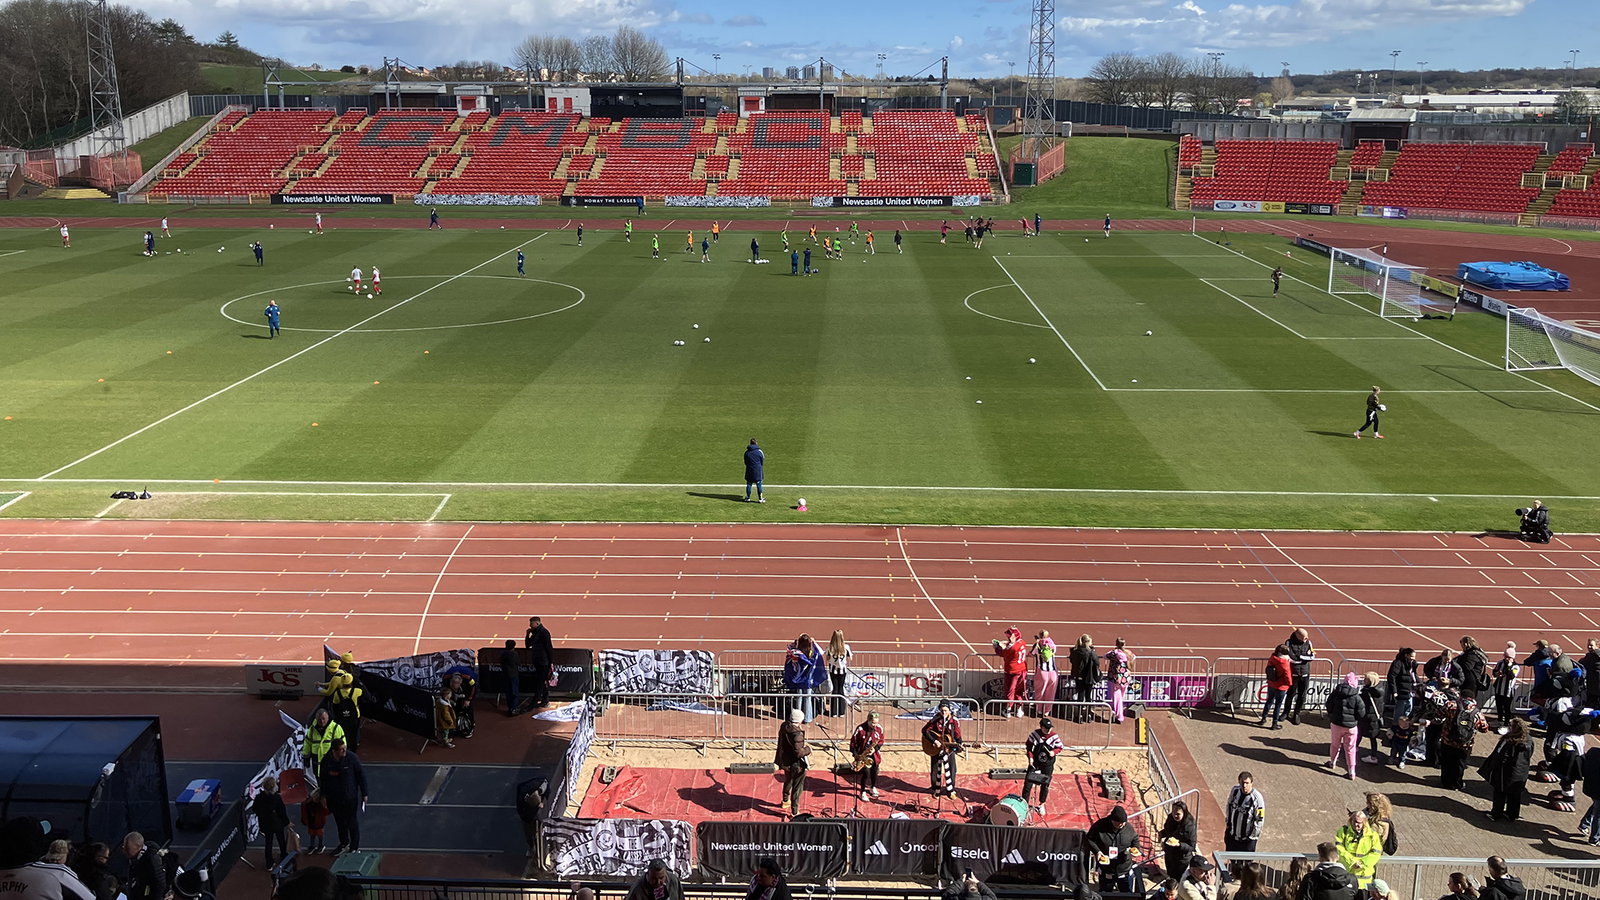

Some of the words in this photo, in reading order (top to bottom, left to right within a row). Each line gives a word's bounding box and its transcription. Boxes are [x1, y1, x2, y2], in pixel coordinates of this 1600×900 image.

[283, 195, 323, 203] Newcastle
[324, 195, 346, 203] United
[842, 197, 883, 206] Newcastle
[885, 197, 912, 205] United
[912, 197, 943, 205] Women
[256, 669, 300, 687] JCS
[851, 681, 886, 690] FUCHS
[1179, 686, 1205, 697] NHS
[711, 842, 760, 851] Newcastle
[763, 842, 795, 851] United
[796, 842, 833, 852] Women
[962, 848, 990, 859] sela
[1049, 852, 1078, 861] noon
[0, 880, 28, 893] RPHY
